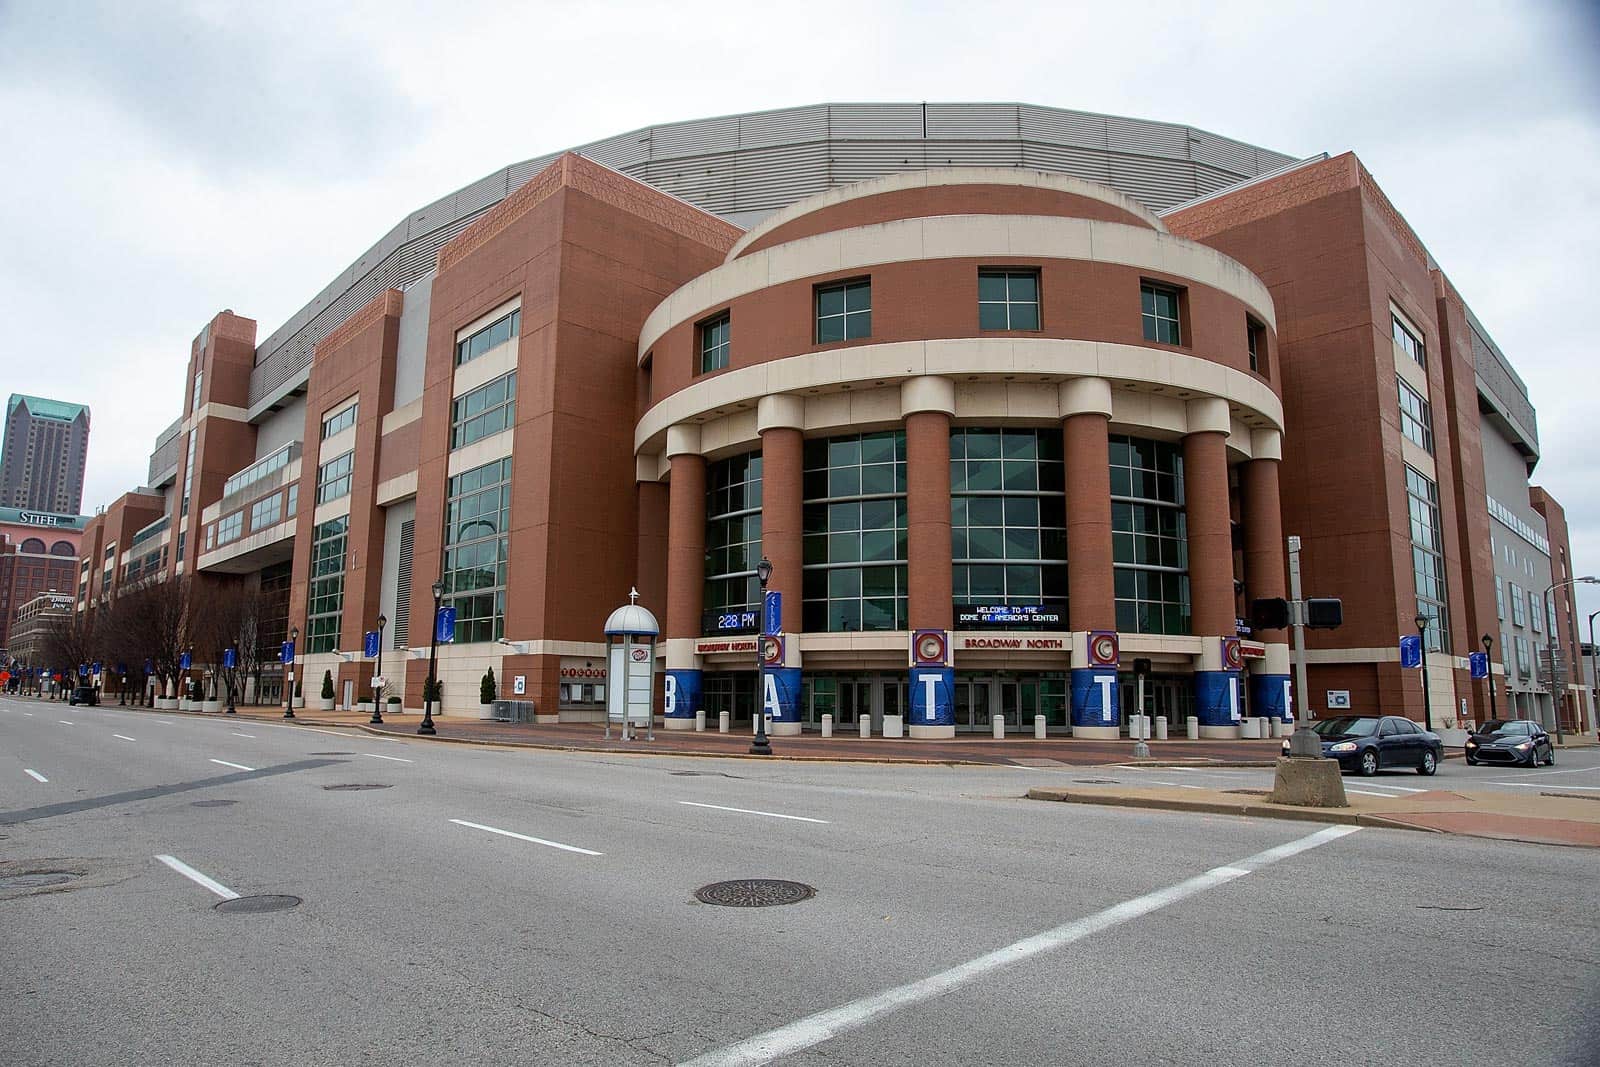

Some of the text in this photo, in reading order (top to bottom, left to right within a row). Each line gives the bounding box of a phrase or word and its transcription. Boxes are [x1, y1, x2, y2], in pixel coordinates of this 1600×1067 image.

[20, 512, 57, 526] STIFEL
[976, 606, 1038, 614] WELCOME TO THE
[741, 612, 755, 627] PM
[960, 614, 1059, 622] DOME AT AMERICA'S CENTER
[731, 641, 757, 652] NORTH
[965, 638, 1063, 649] BROADWAY NORTH
[918, 673, 943, 721] T
[1094, 675, 1115, 720] T
